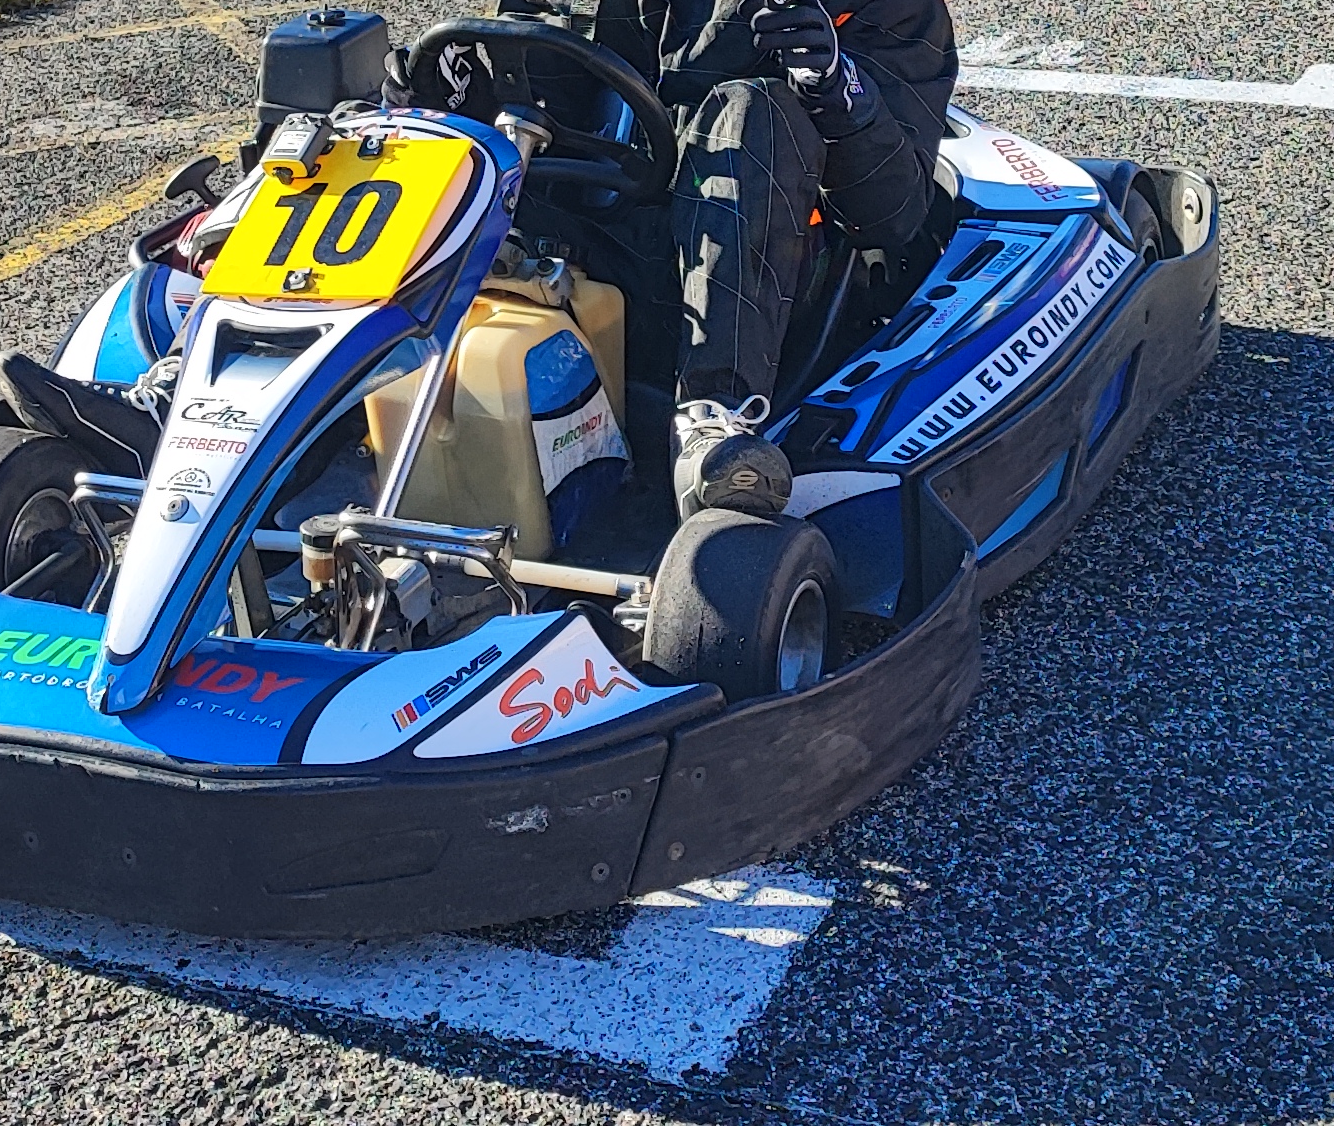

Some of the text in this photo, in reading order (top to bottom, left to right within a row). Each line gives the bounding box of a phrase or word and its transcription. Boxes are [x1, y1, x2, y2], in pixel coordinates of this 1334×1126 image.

[991, 138, 1069, 203] FERBERTO
[264, 179, 403, 266] 10
[168, 436, 247, 454] FERBERTO
[552, 412, 603, 452] EUROINDY
[425, 644, 503, 708] SWS
[499, 658, 641, 744] Sodi
[175, 696, 283, 729] BATALHA
